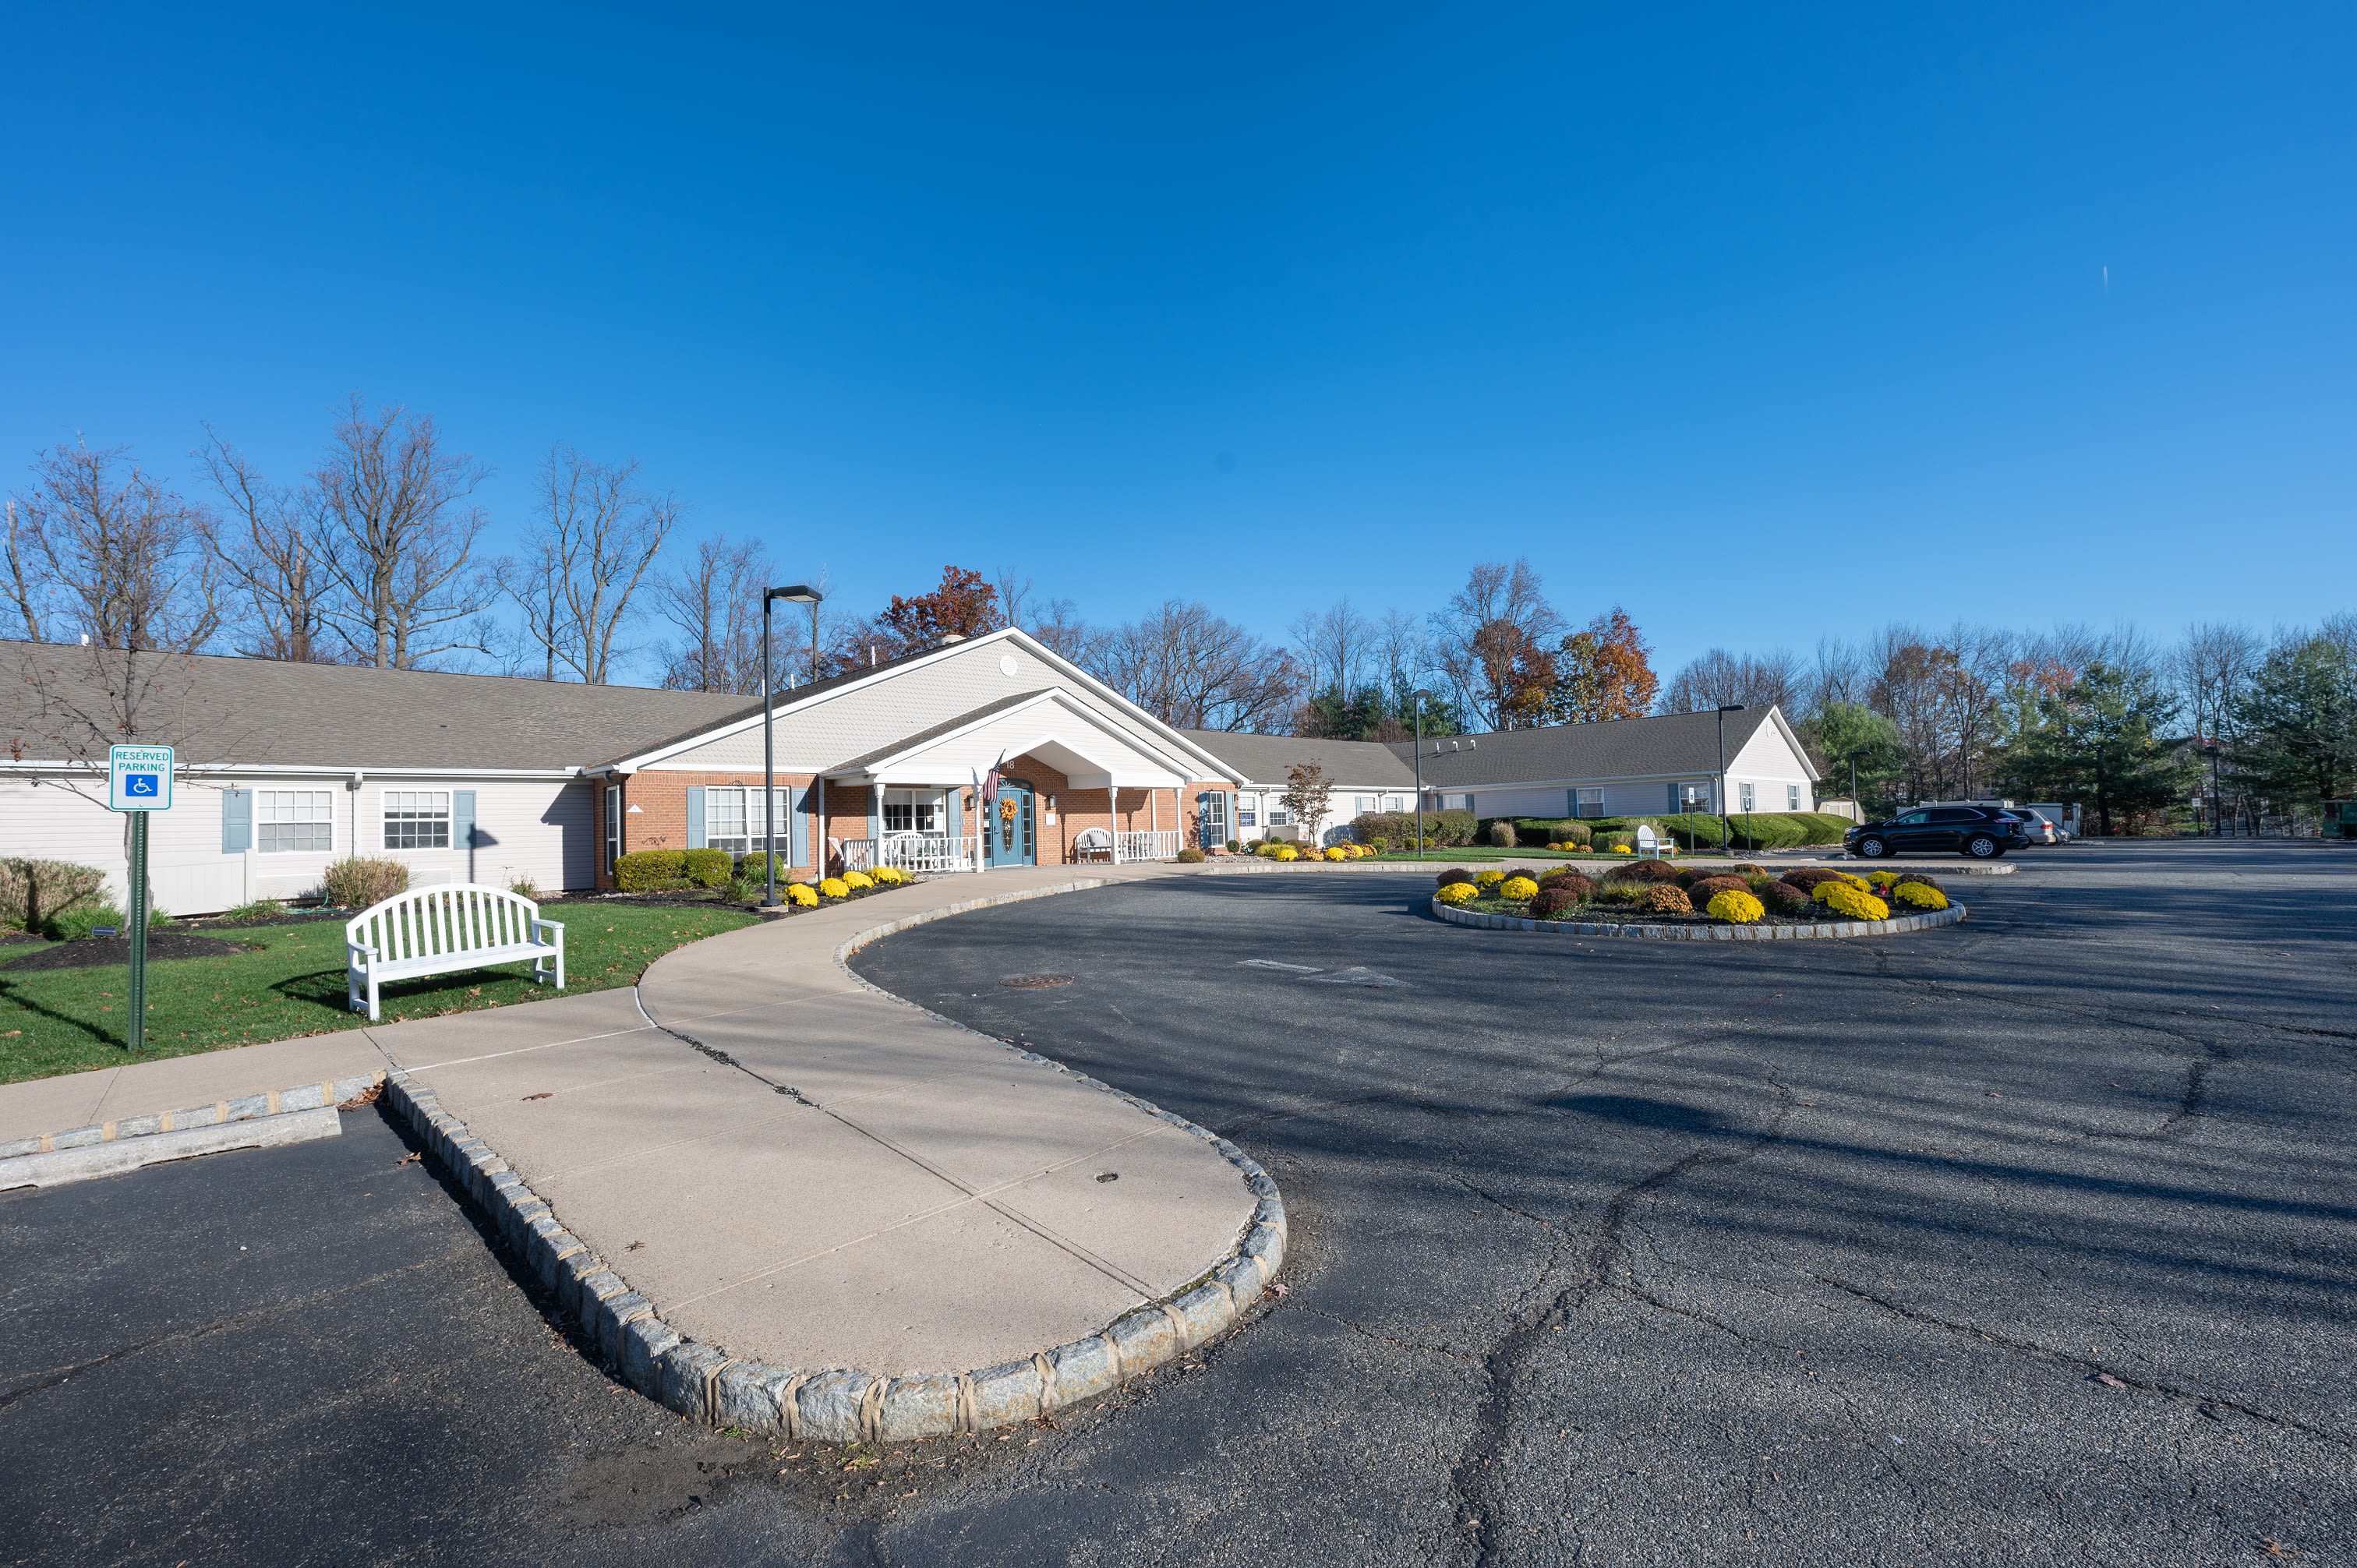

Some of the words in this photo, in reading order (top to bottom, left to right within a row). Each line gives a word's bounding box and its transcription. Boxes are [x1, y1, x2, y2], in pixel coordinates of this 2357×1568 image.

[115, 751, 169, 761] RESERVED
[118, 762, 165, 772] PARKING
[1005, 761, 1015, 769] 18
